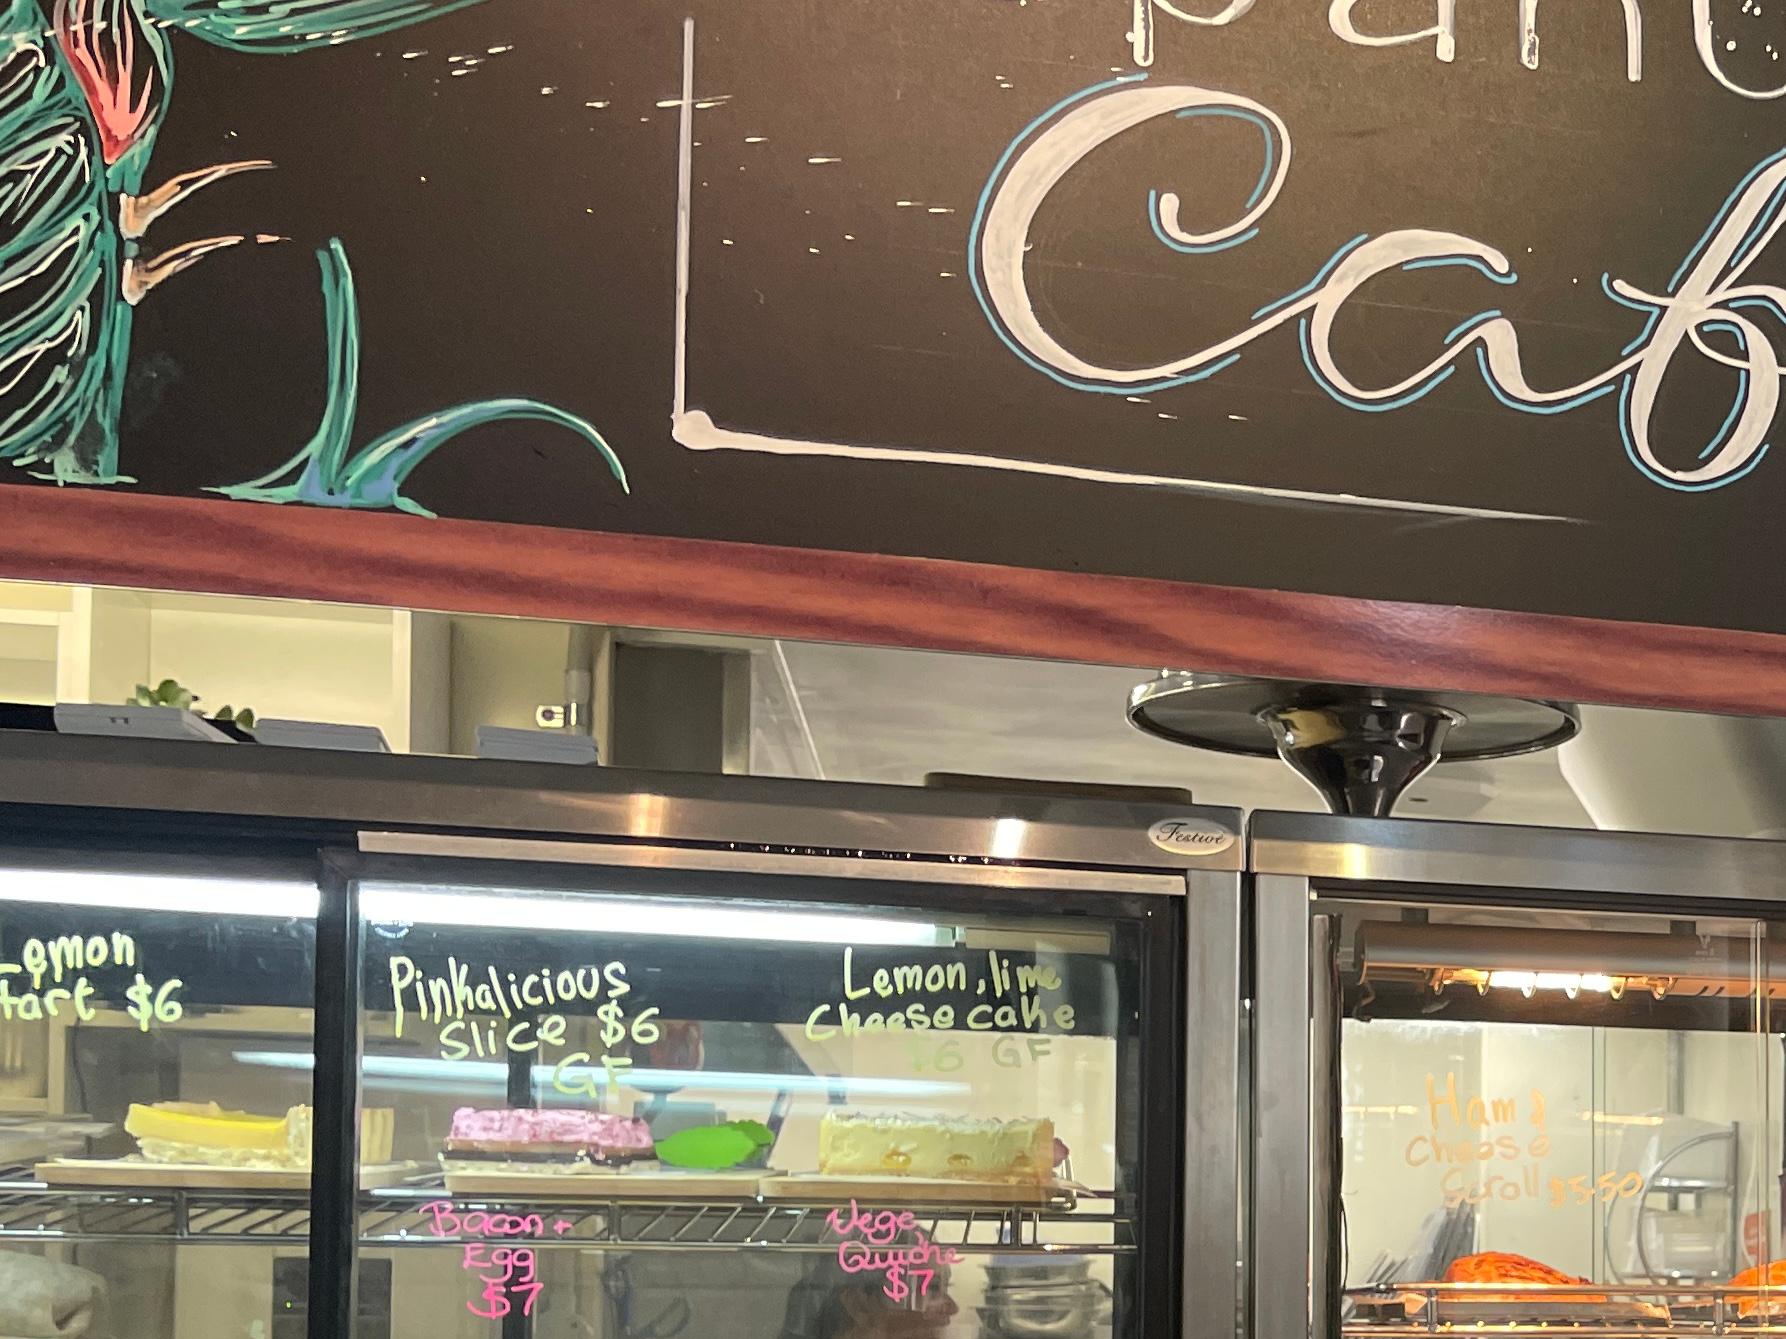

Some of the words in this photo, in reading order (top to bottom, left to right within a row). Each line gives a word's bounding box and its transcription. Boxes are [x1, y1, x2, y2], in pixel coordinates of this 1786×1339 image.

[0, 932, 135, 990] emon
[127, 973, 184, 1032] $6
[389, 955, 631, 1039] Pinkalicious
[597, 1000, 660, 1048] $6
[553, 1052, 633, 1099] GF
[419, 1200, 544, 1238] Bacon
[463, 1243, 535, 1283] Egg
[883, 1264, 934, 1302] $7
